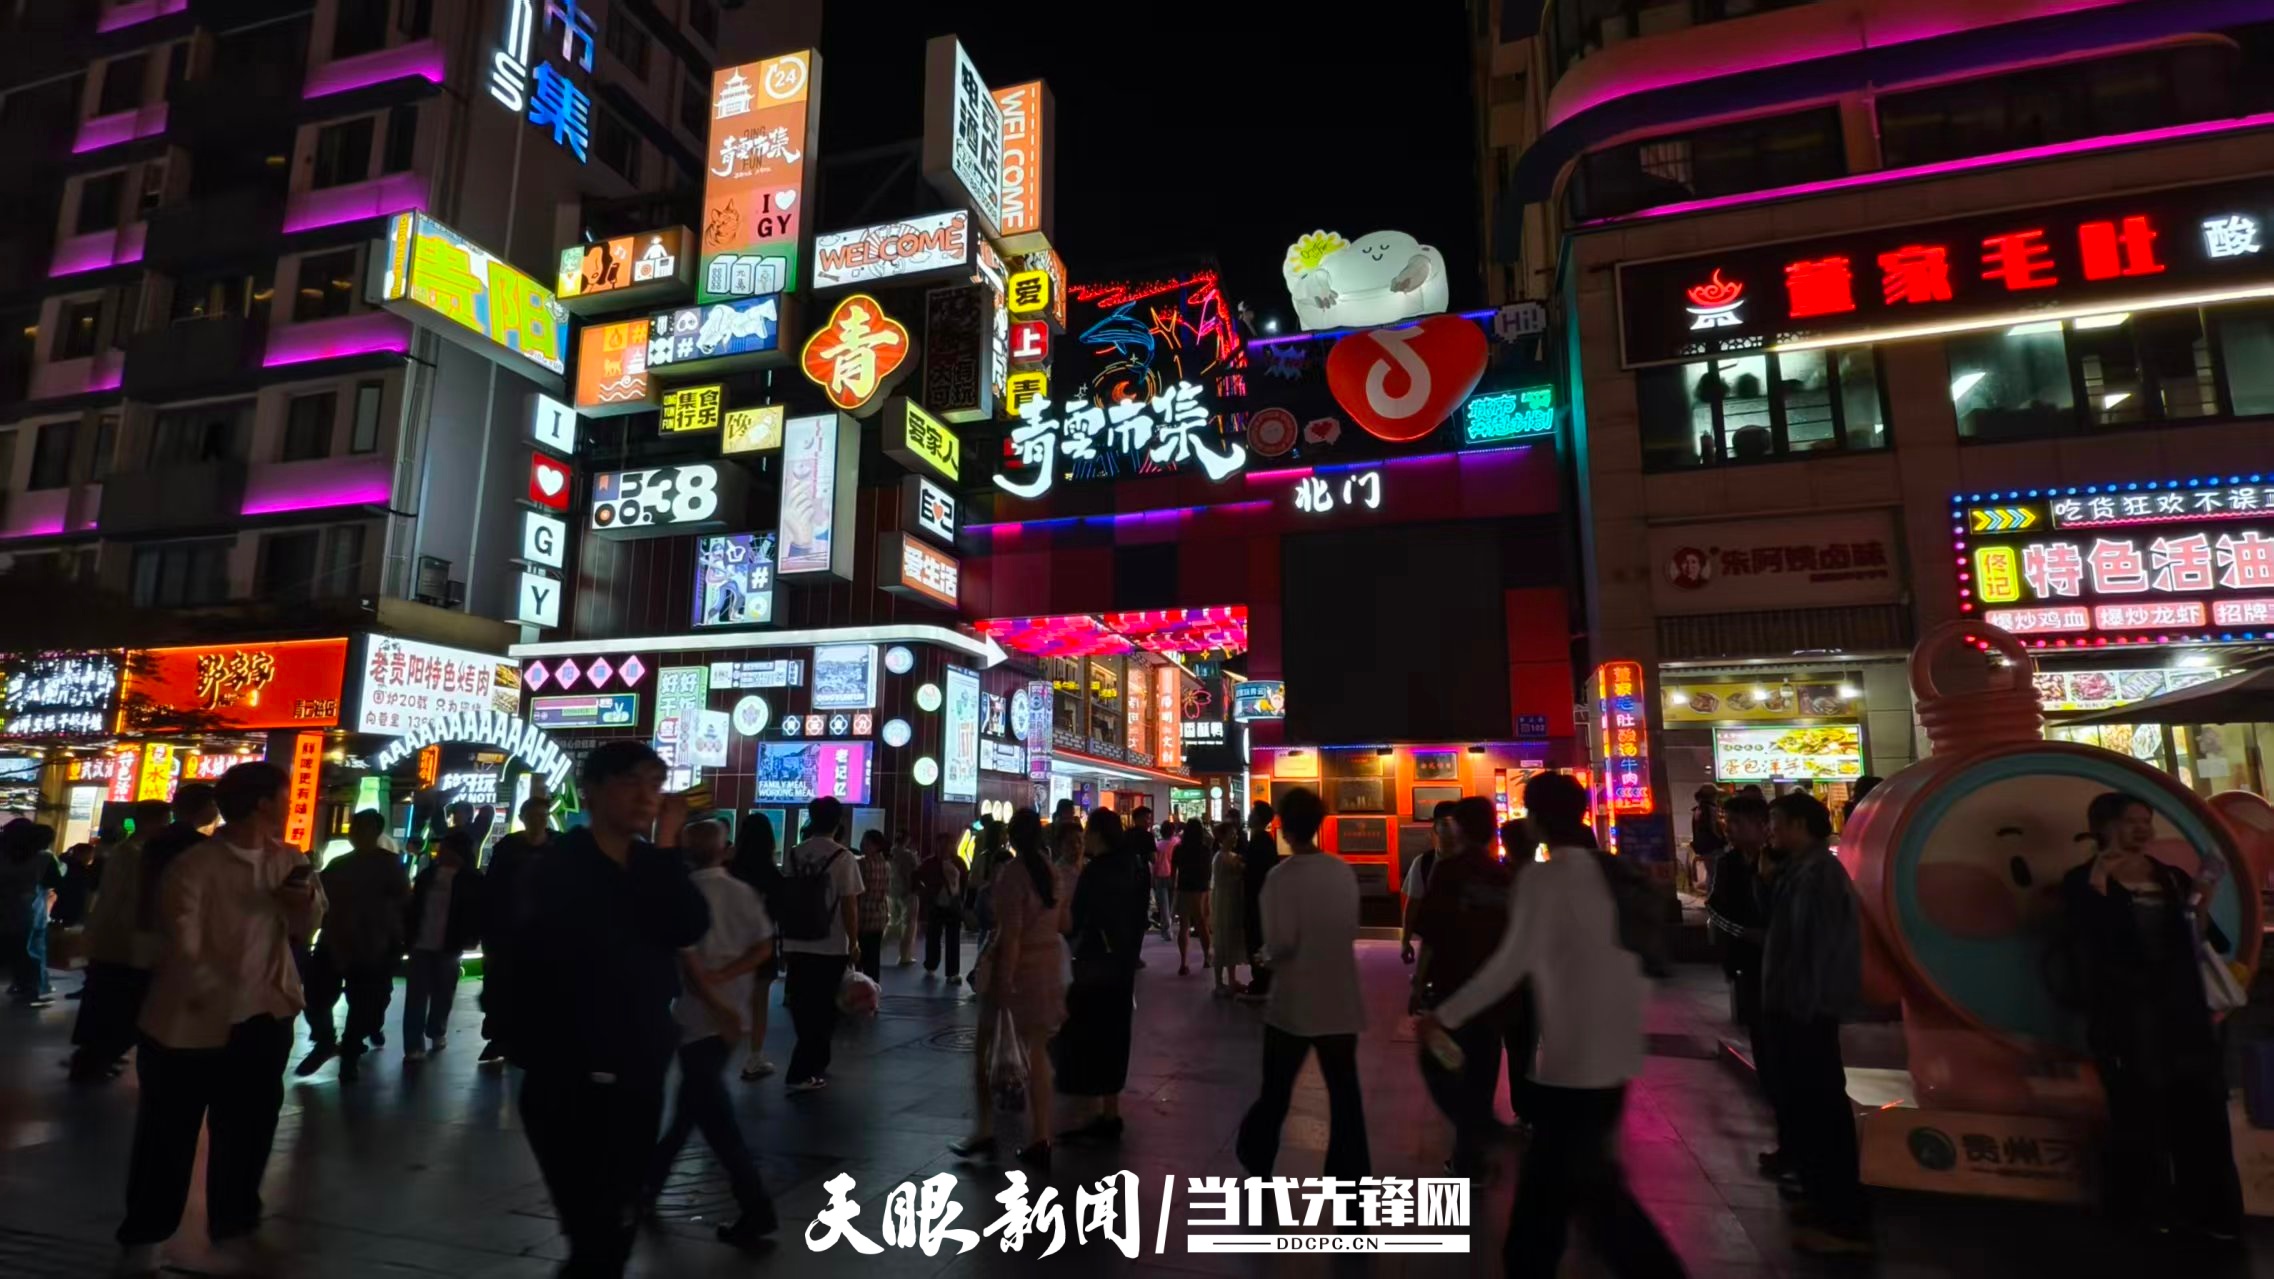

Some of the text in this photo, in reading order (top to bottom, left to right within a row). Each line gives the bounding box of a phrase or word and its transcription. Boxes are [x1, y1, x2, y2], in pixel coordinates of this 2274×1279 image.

[529, 0, 598, 164] 市集
[775, 69, 797, 88] 24
[1001, 88, 1026, 228] WELCOME
[762, 193, 770, 213] I
[757, 213, 792, 238] GY
[2202, 214, 2262, 260] 酸
[819, 225, 963, 272] WELCOME
[1785, 215, 2167, 319] 董家毛肚
[1503, 313, 1541, 342] Hi!
[819, 304, 900, 398] 青
[551, 411, 561, 439] I
[908, 410, 958, 471] 爱家人
[921, 490, 953, 534] 自己
[1295, 471, 1382, 513] 北门
[903, 545, 958, 599] 爱生活
[2100, 605, 2202, 627] 爆炒龙虾
[369, 649, 490, 696] 老贵阳特色烤肉
[660, 672, 698, 694] 好好
[470, 792, 497, 803] NOT!
[758, 780, 807, 789] FAMILY MEAL
[758, 788, 816, 798] WORKING MEAL
